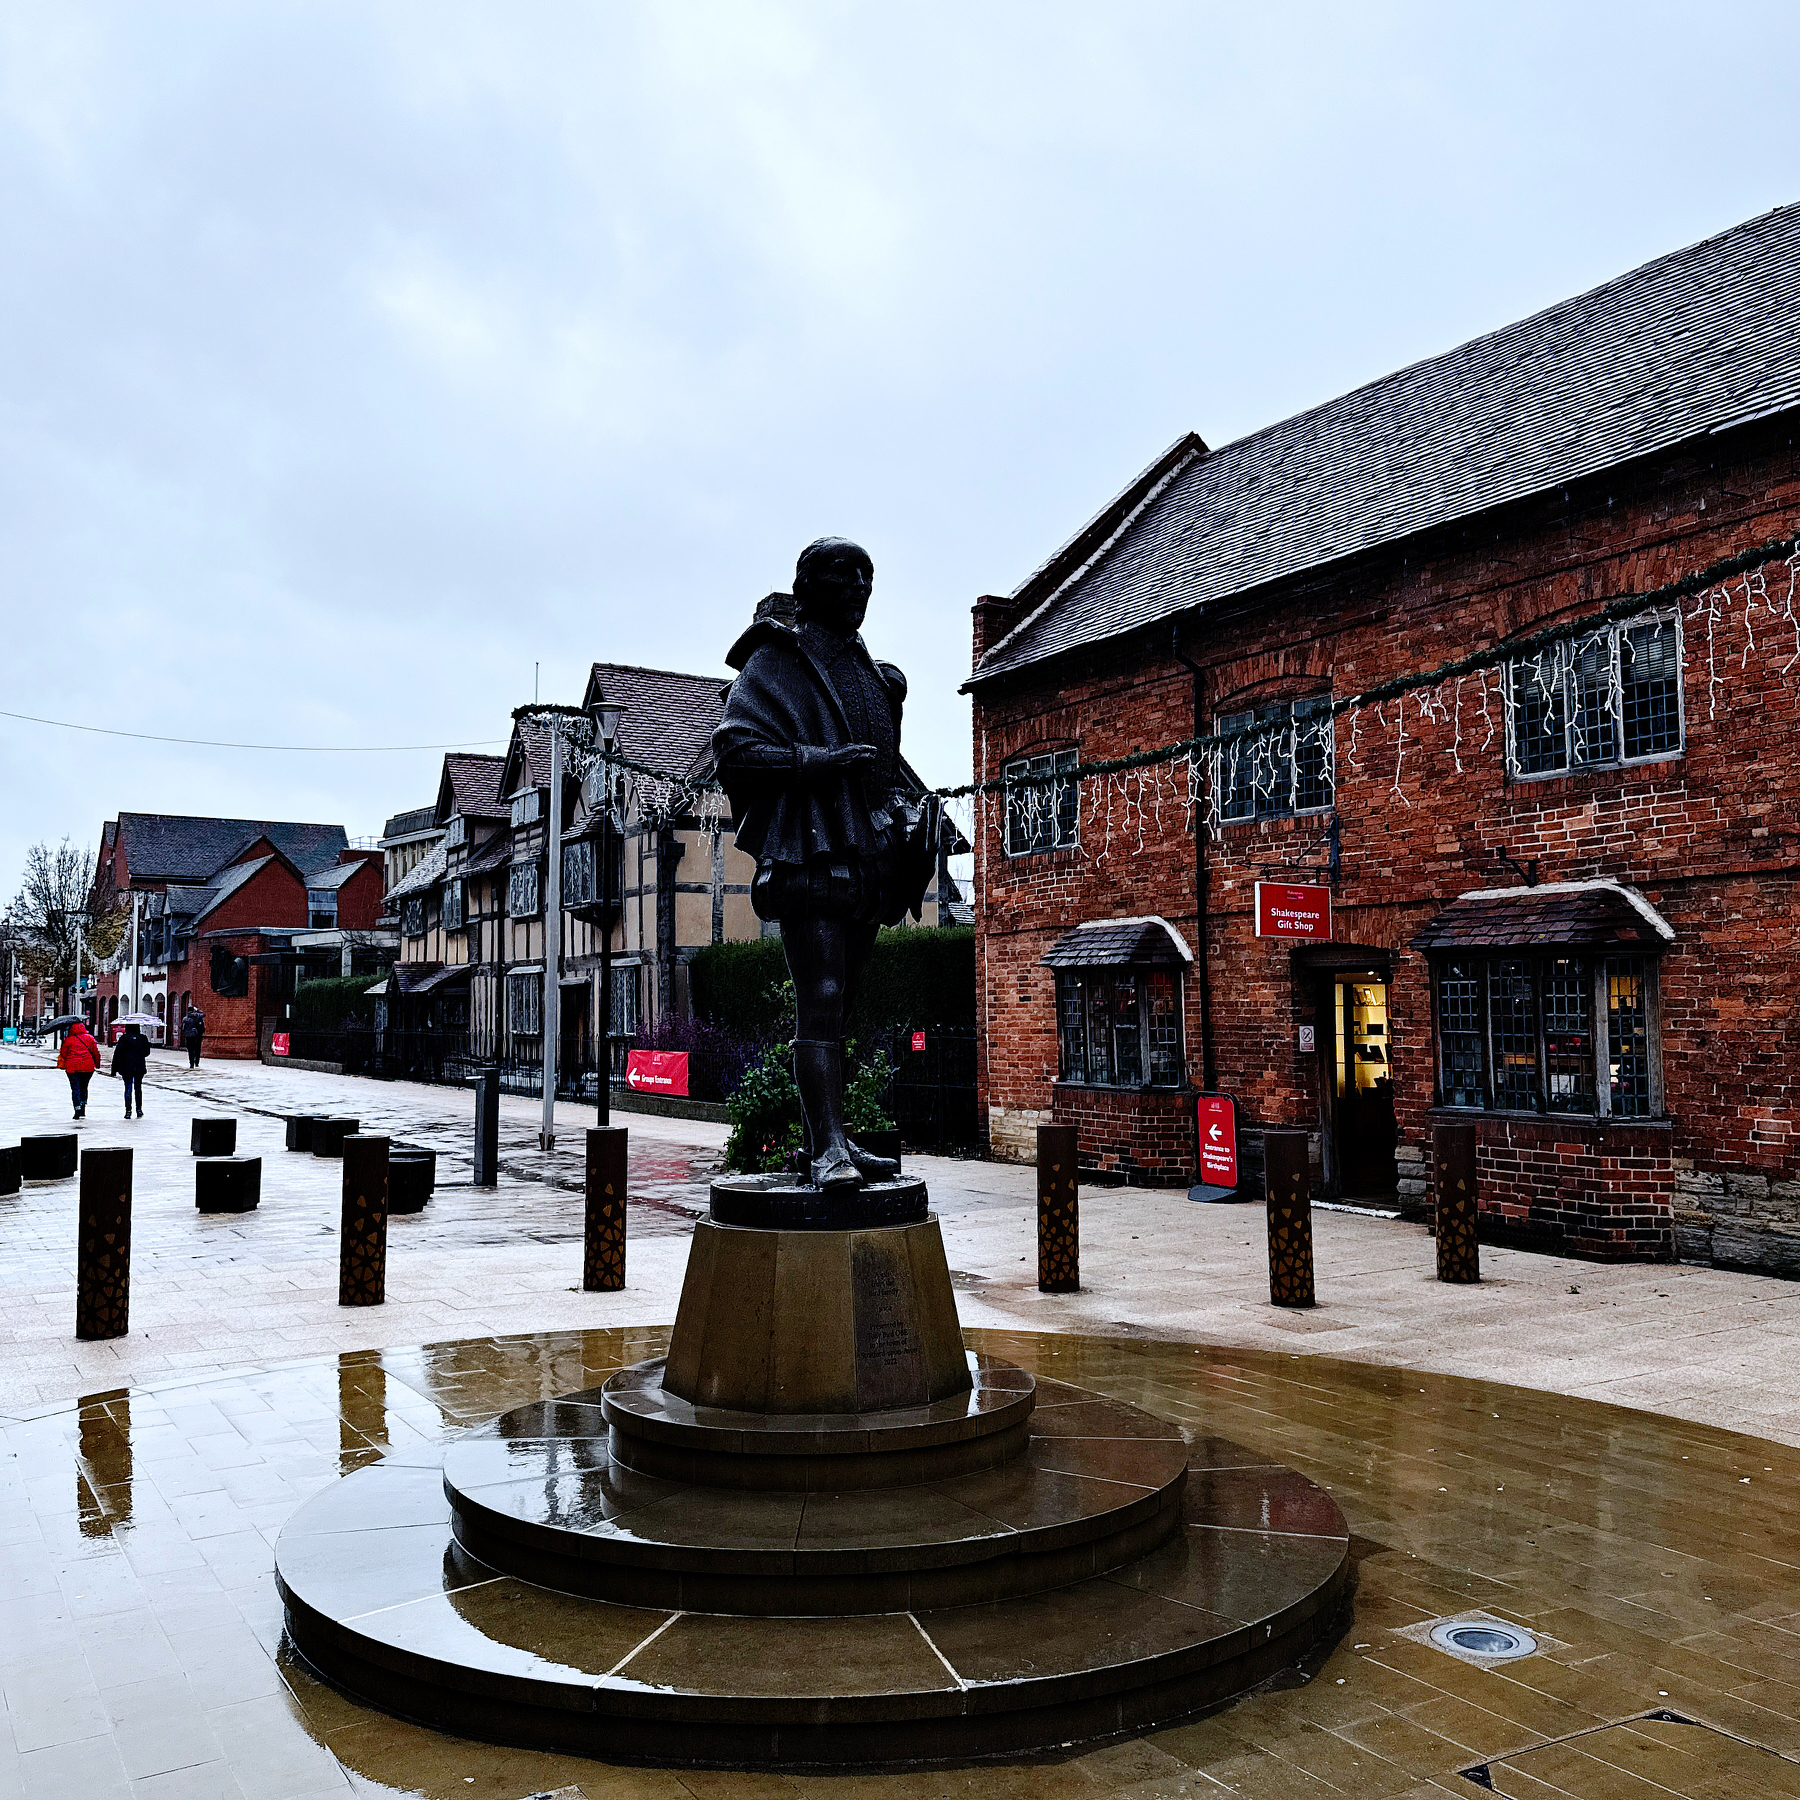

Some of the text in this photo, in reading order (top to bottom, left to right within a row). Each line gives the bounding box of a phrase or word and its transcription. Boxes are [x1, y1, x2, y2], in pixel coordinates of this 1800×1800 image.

[1271, 907, 1320, 920] Shakespeare
[1277, 920, 1314, 932] Gift Shop
[641, 1074, 672, 1085] Groups Entrance
[1205, 1143, 1224, 1152] Entrance
[1203, 1152, 1233, 1162] Shakespeare's
[1206, 1161, 1229, 1171] Birthplace
